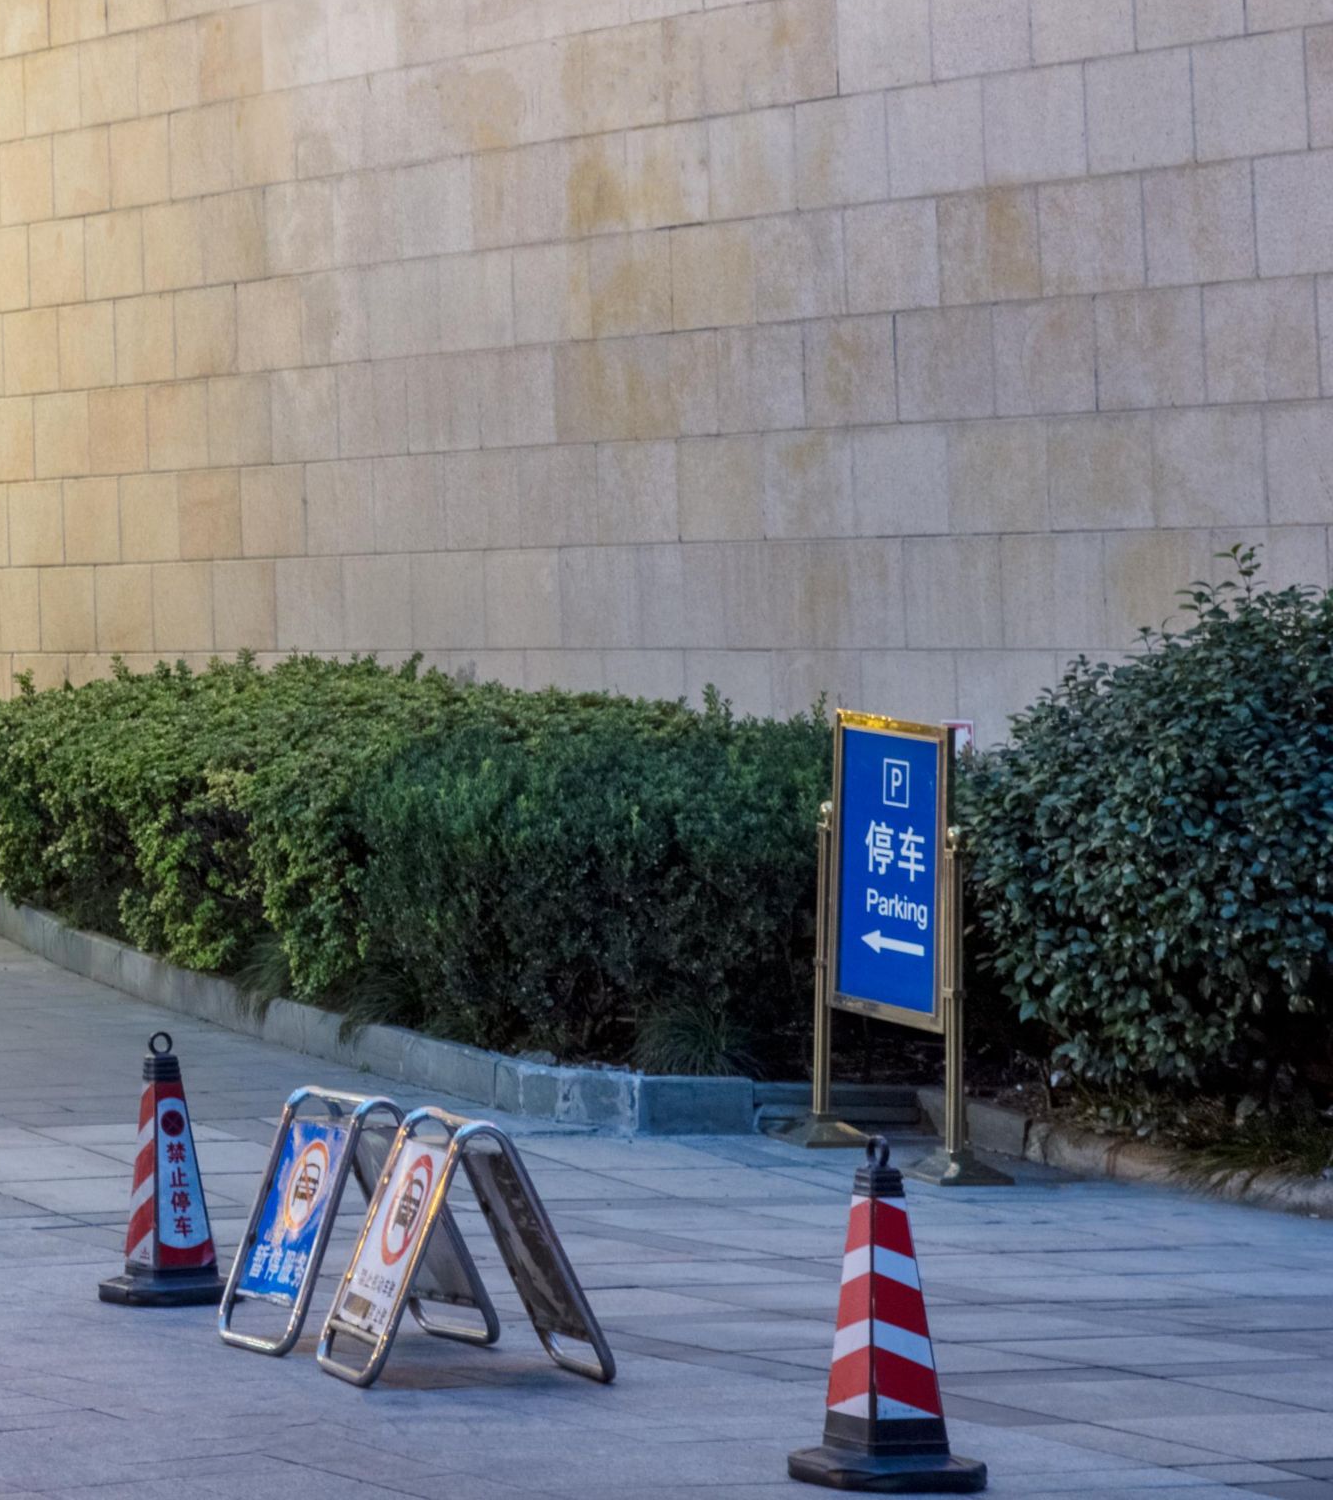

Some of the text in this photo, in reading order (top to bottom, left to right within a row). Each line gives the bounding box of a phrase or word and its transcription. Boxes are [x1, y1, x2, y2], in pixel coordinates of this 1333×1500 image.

[864, 819, 926, 882] 停车
[865, 887, 929, 930] Parking
[166, 1141, 194, 1238] 禁止停车
